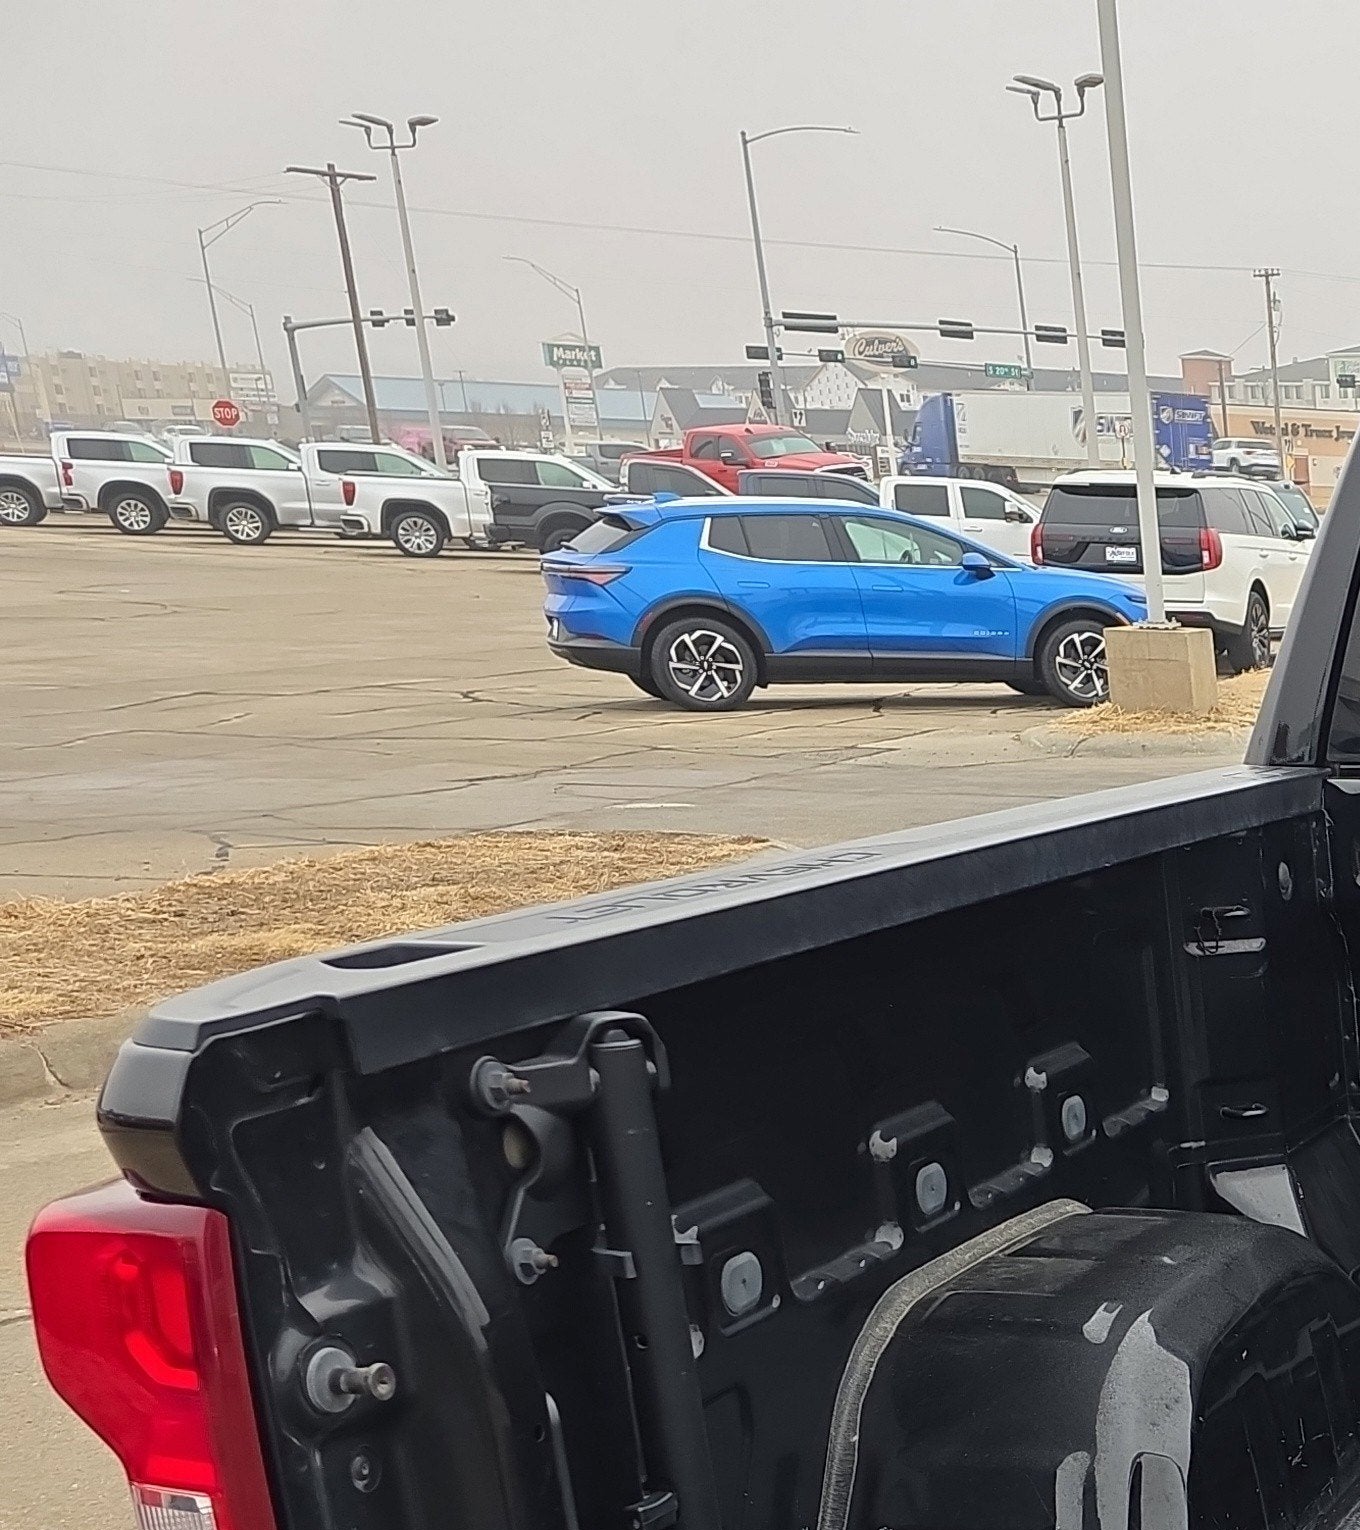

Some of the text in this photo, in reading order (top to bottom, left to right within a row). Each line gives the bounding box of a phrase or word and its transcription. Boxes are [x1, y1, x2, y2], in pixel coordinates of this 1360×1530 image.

[552, 346, 597, 362] Market
[856, 338, 905, 357] Culver's
[989, 365, 994, 375] S
[213, 407, 238, 420] STOP
[1290, 423, 1300, 437] &
[544, 851, 883, 925] CHEVROLET
